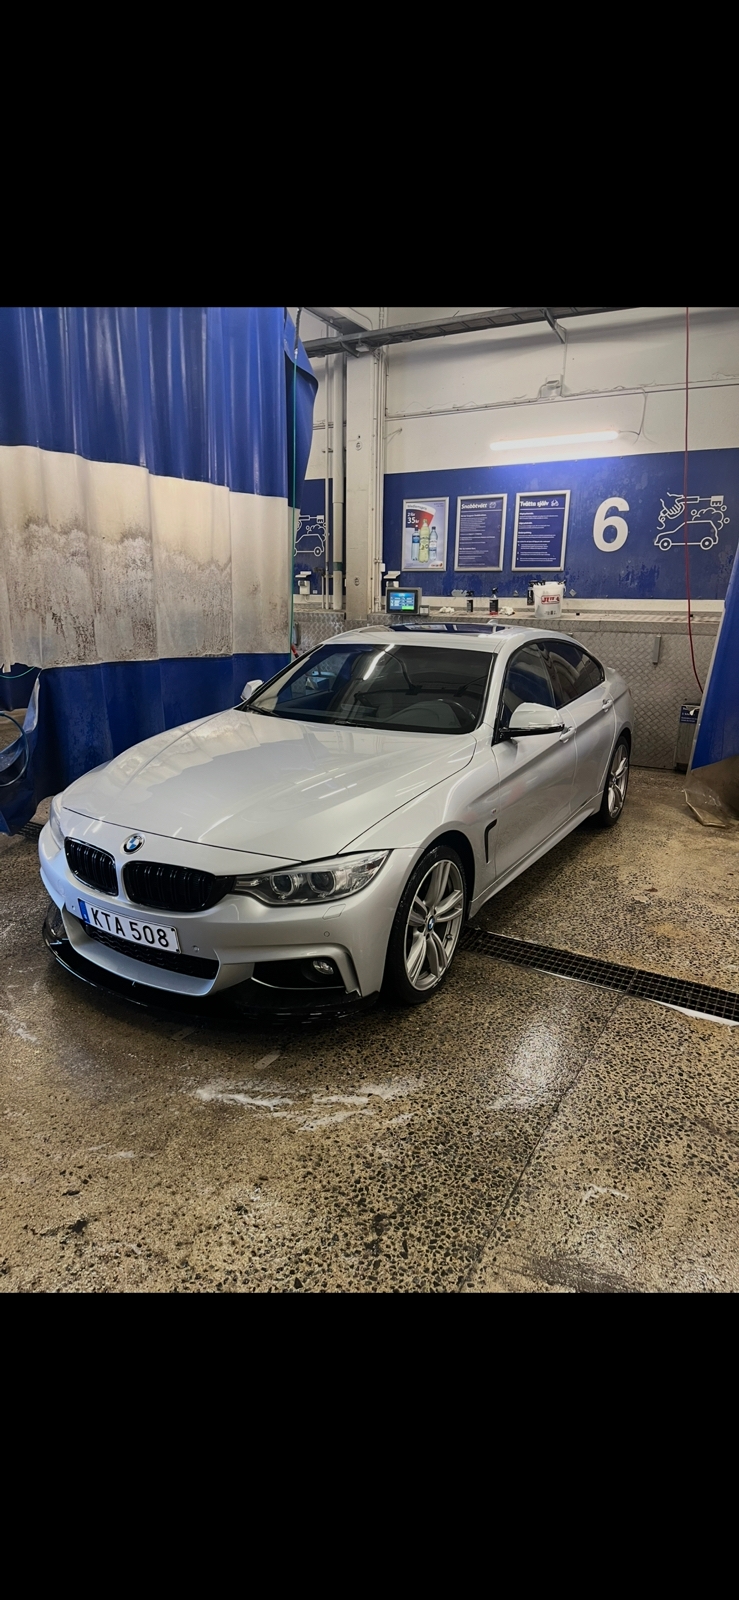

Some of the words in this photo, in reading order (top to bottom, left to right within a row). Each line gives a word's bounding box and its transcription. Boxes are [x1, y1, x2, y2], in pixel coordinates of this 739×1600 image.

[537, 500, 549, 508] själv
[593, 496, 630, 552] 6
[91, 907, 126, 937] KTA
[129, 921, 169, 947] 508
